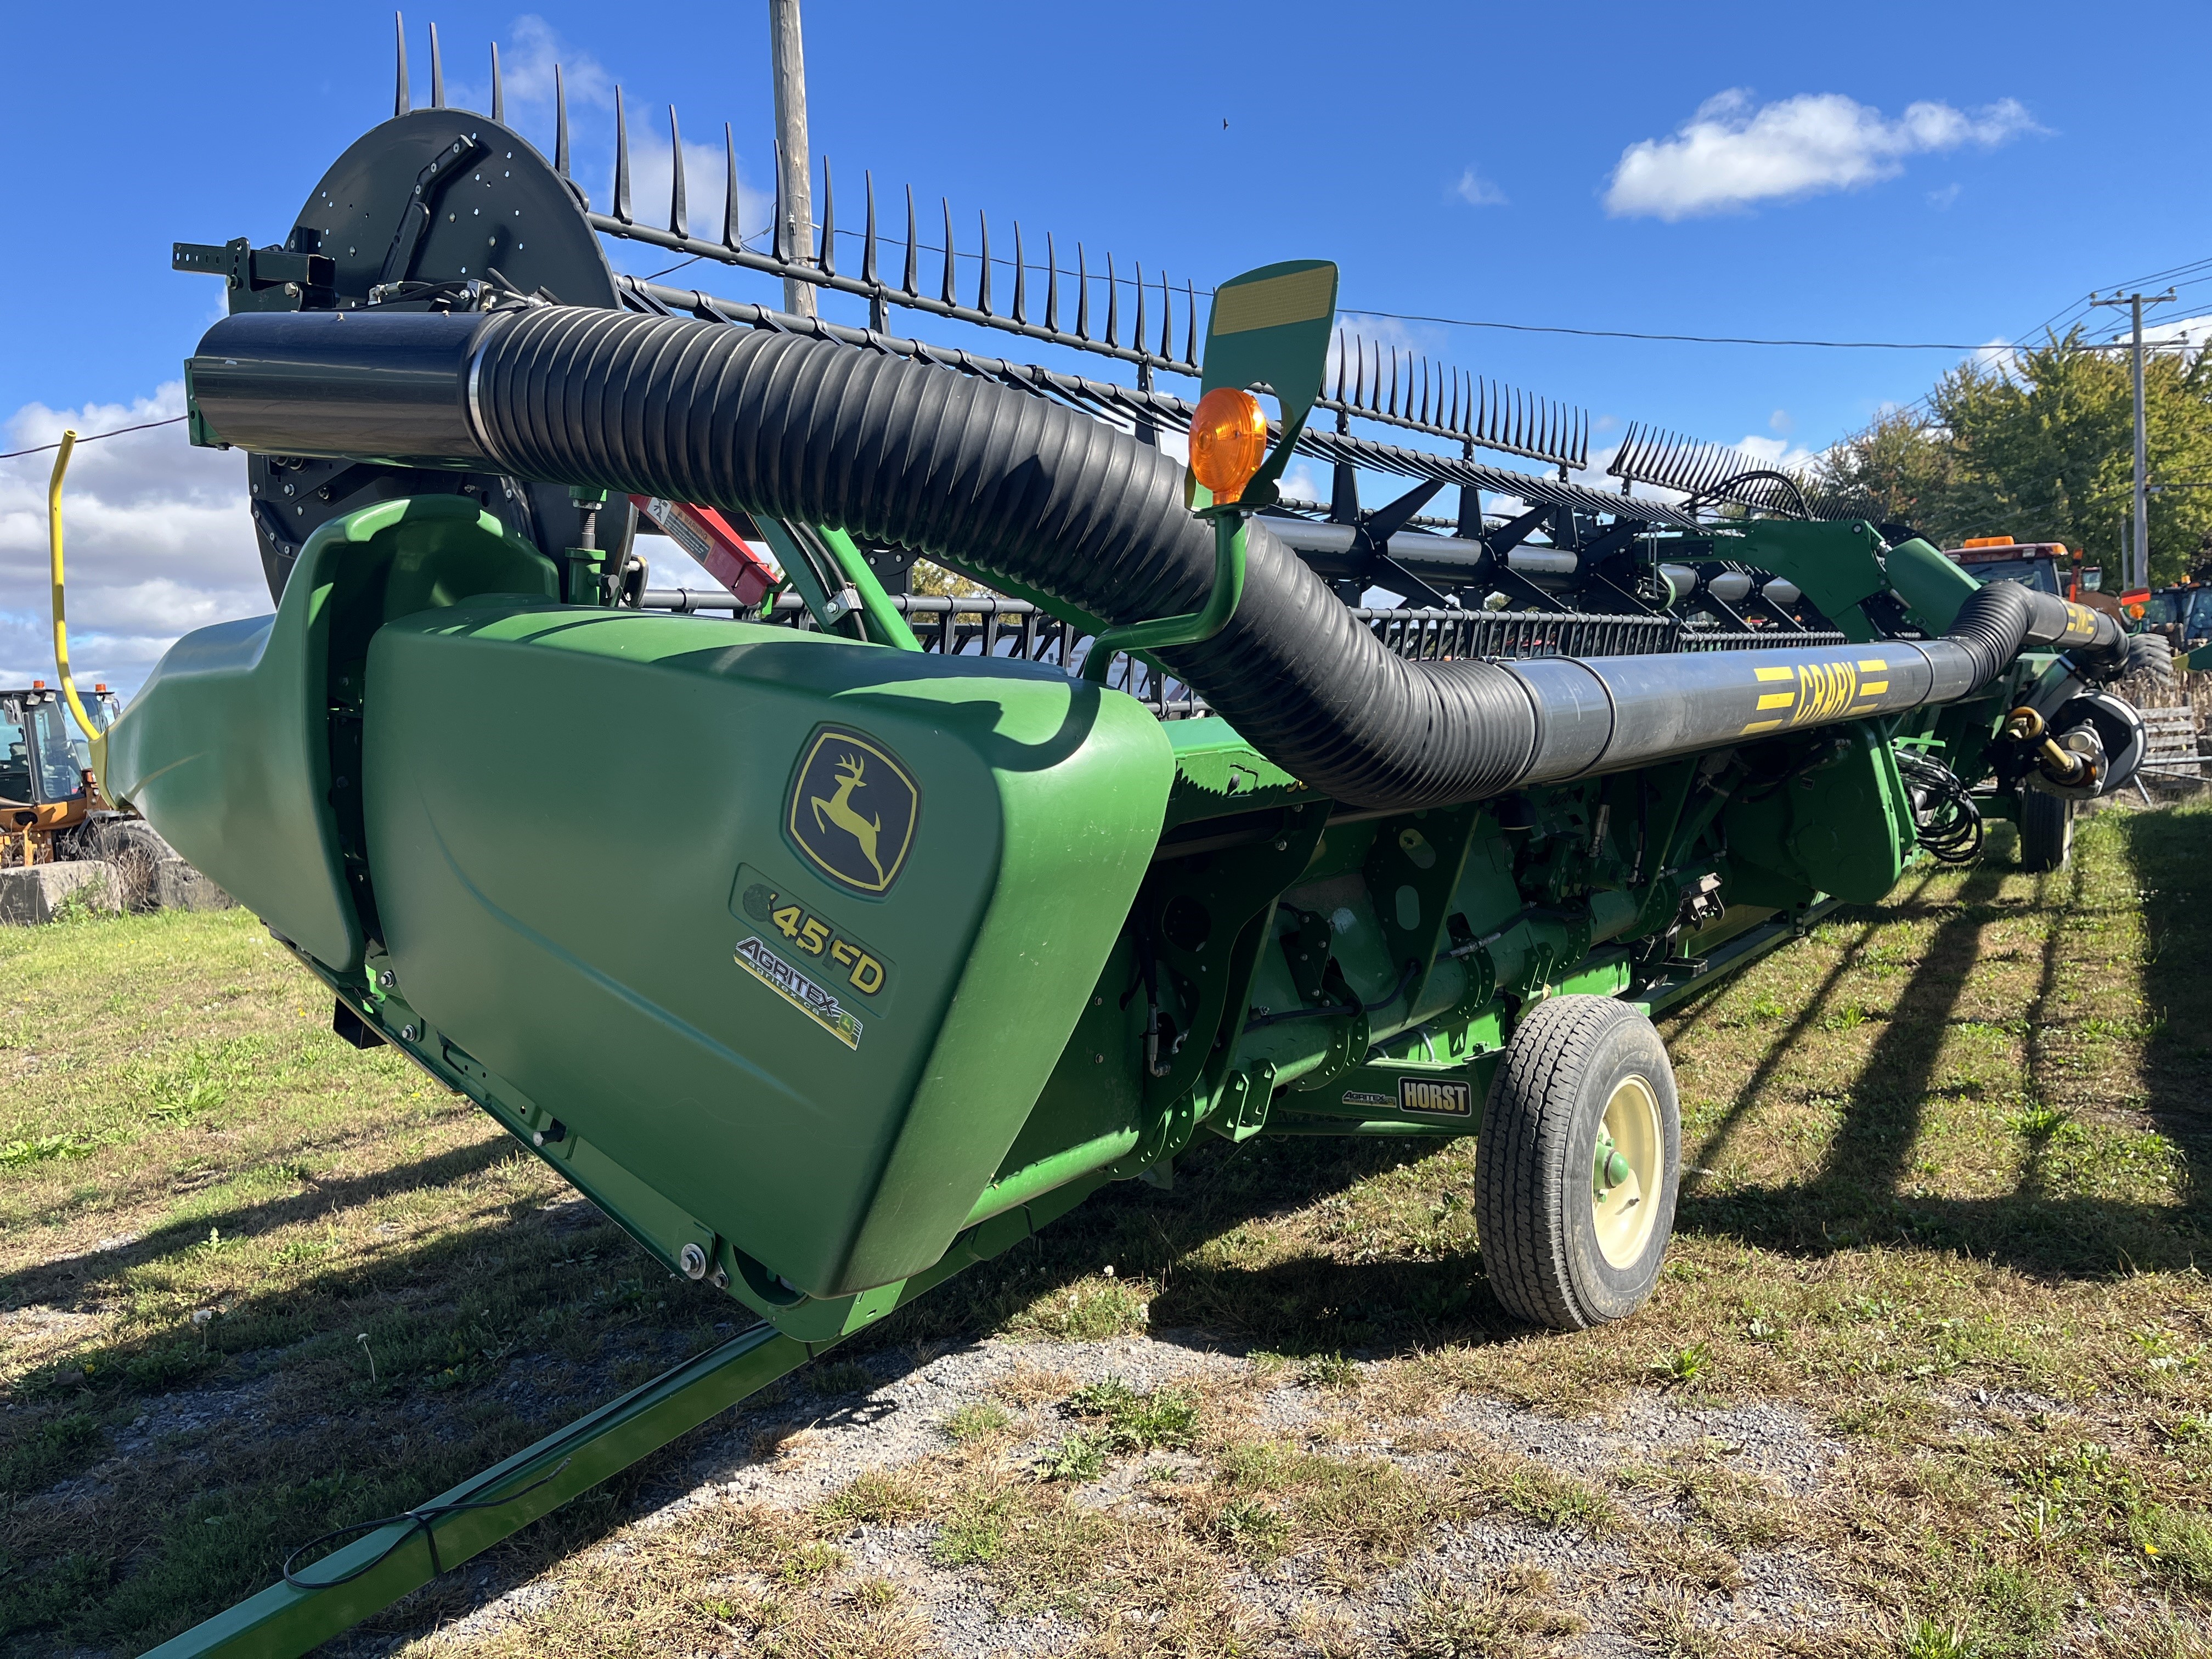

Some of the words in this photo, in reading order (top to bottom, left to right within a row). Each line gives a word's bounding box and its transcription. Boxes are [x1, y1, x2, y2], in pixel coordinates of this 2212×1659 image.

[684, 515, 708, 540] WARNING
[1789, 662, 1856, 727] CRARY
[736, 937, 837, 1017] AGRITEX
[748, 961, 820, 1017] agritex.ca
[1343, 1091, 1385, 1102] AGRITEX
[1404, 1082, 1467, 1111] HORST
